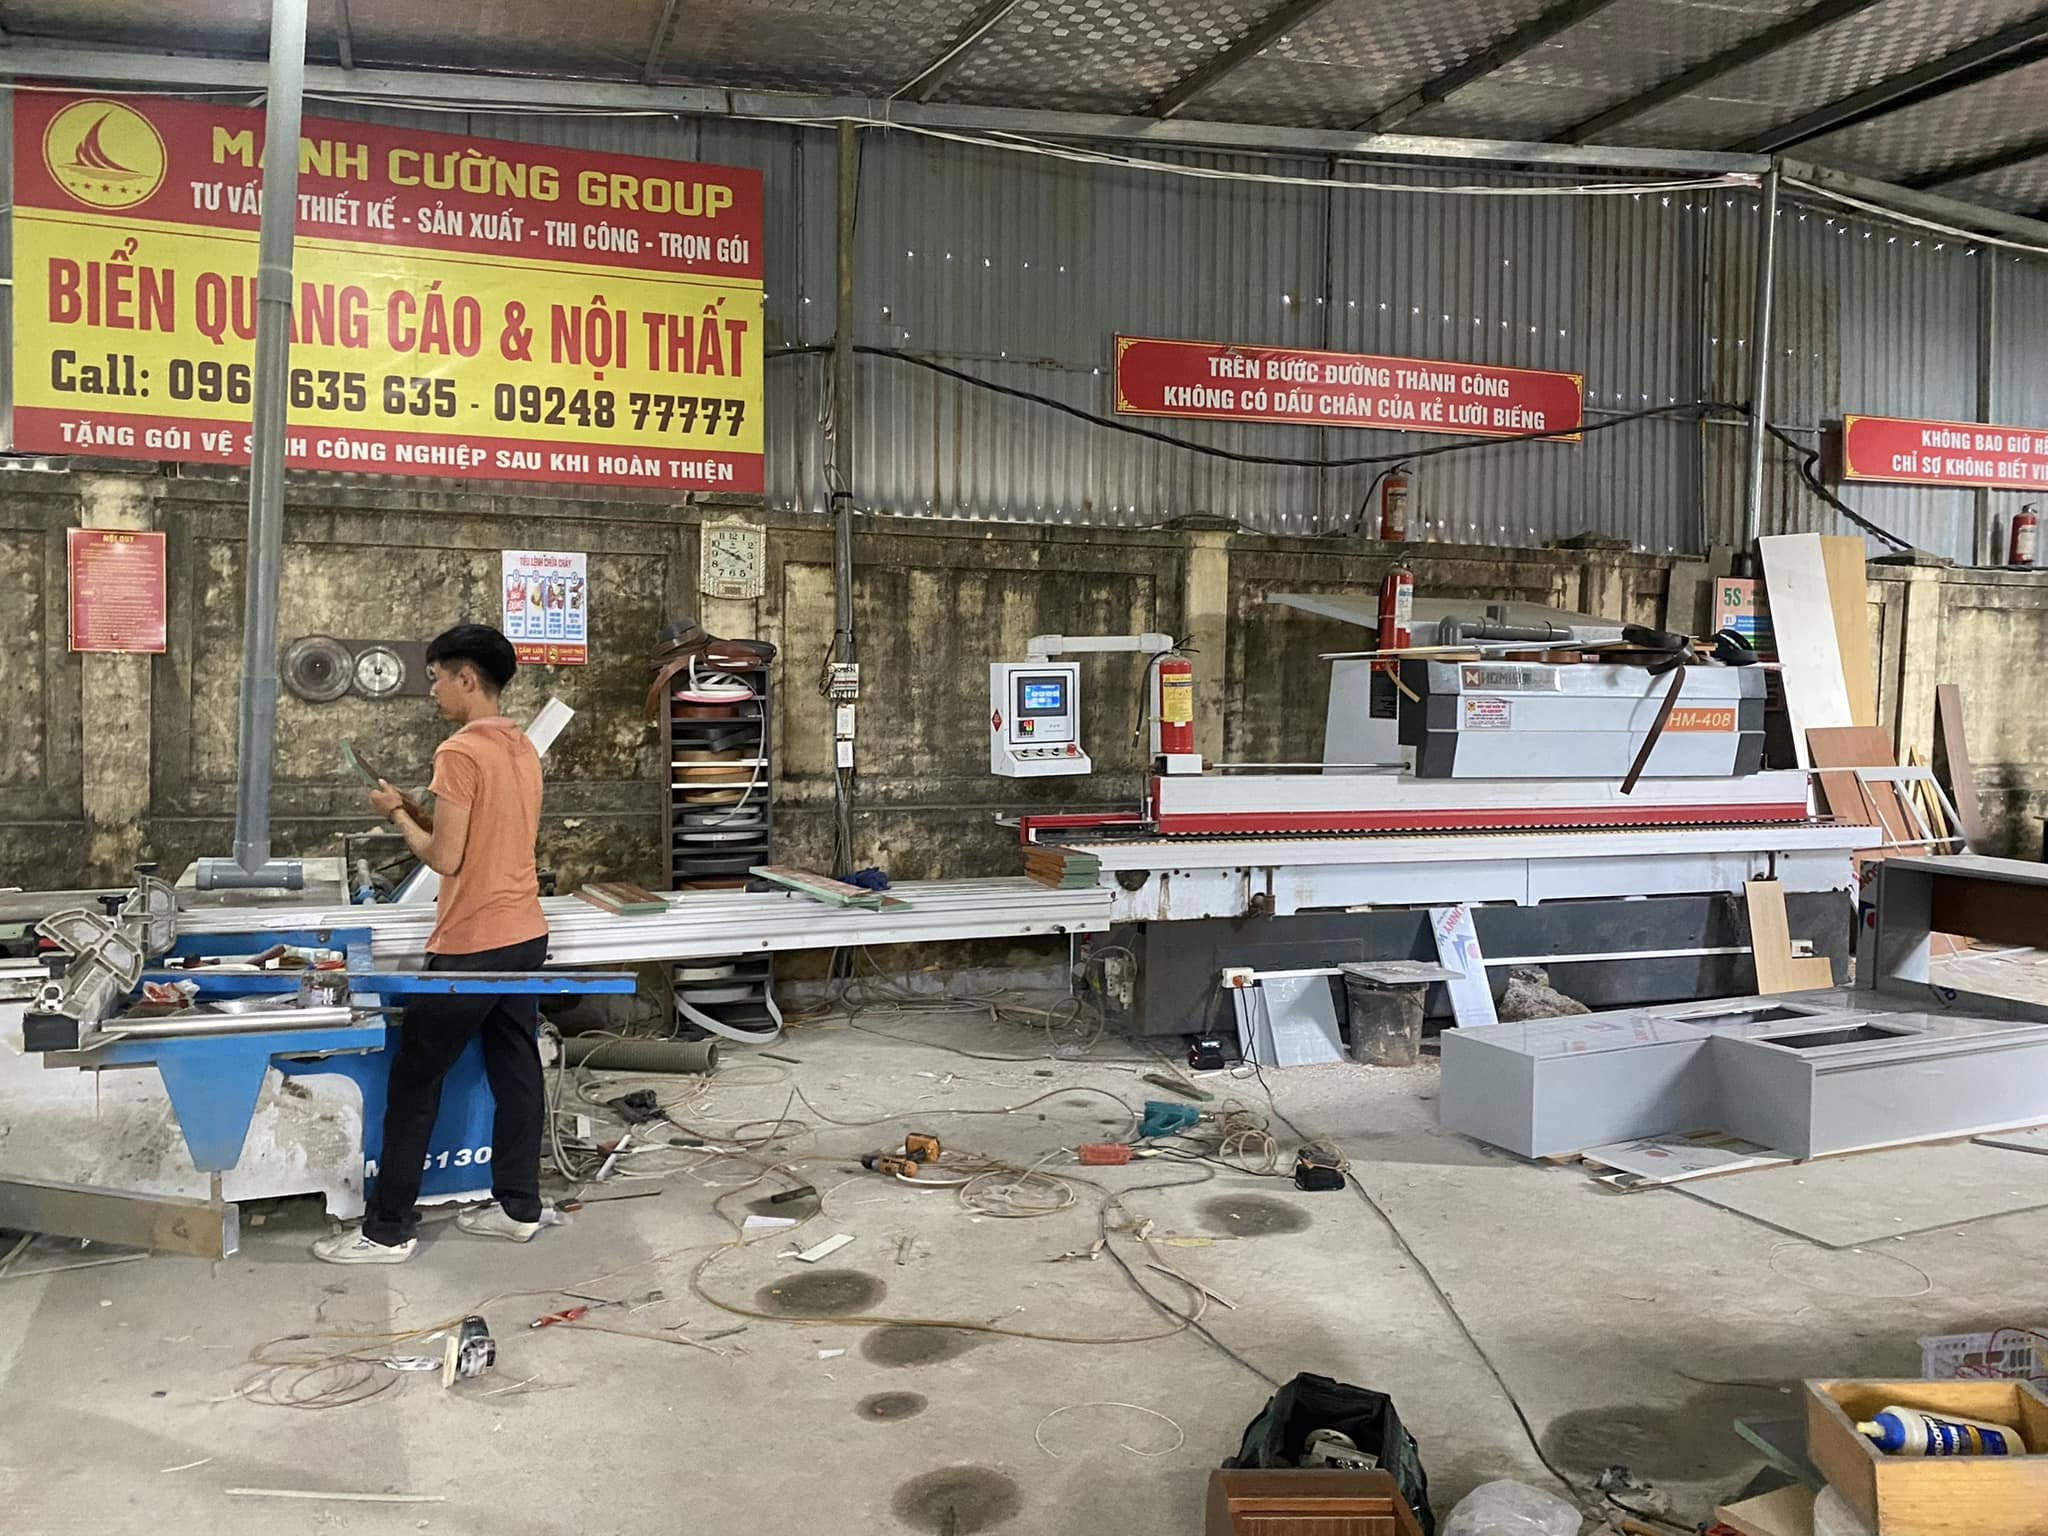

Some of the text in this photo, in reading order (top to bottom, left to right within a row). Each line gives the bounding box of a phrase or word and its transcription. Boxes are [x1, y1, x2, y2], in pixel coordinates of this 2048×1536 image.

[213, 126, 733, 218] MNH CƯỜNG GROUP
[191, 181, 223, 211] TƯ
[227, 179, 263, 215] VẤ
[298, 191, 361, 226] THIẾT
[367, 195, 397, 230] KẾ
[417, 200, 463, 237] SẢN
[469, 208, 524, 242] XUẤT
[545, 220, 577, 248] THI
[583, 221, 639, 253] CÔNG
[659, 232, 711, 265] TRỌN
[717, 235, 750, 264] GÓI
[49, 237, 748, 381] BIỂN QUNG CÁO & NỘI THẤT
[51, 349, 149, 398] Call:
[168, 358, 252, 405] 096
[290, 368, 366, 412] 635
[383, 375, 457, 418] 635
[494, 383, 615, 429] 09248
[629, 393, 746, 437] 77777
[1208, 355, 1510, 398] TRÊN BƯỚC ĐƯỜNG THÀNH CÔNG
[1164, 383, 1545, 430] KHÔNG CÓ DẤU CHÂN CỦA KẺ LƯỜI BIẾNG
[60, 420, 734, 484] TẶNG GÓI VỆ SH CÔNG NGHIỆP SAU KHI HOÀN THIỆN
[1892, 450, 2048, 481] CHỈ SỢ KHÔNG BIẾT VI
[1921, 428, 1970, 449] KHÔNG
[1975, 434, 2003, 452] BAO
[1724, 586, 1742, 607] 5S
